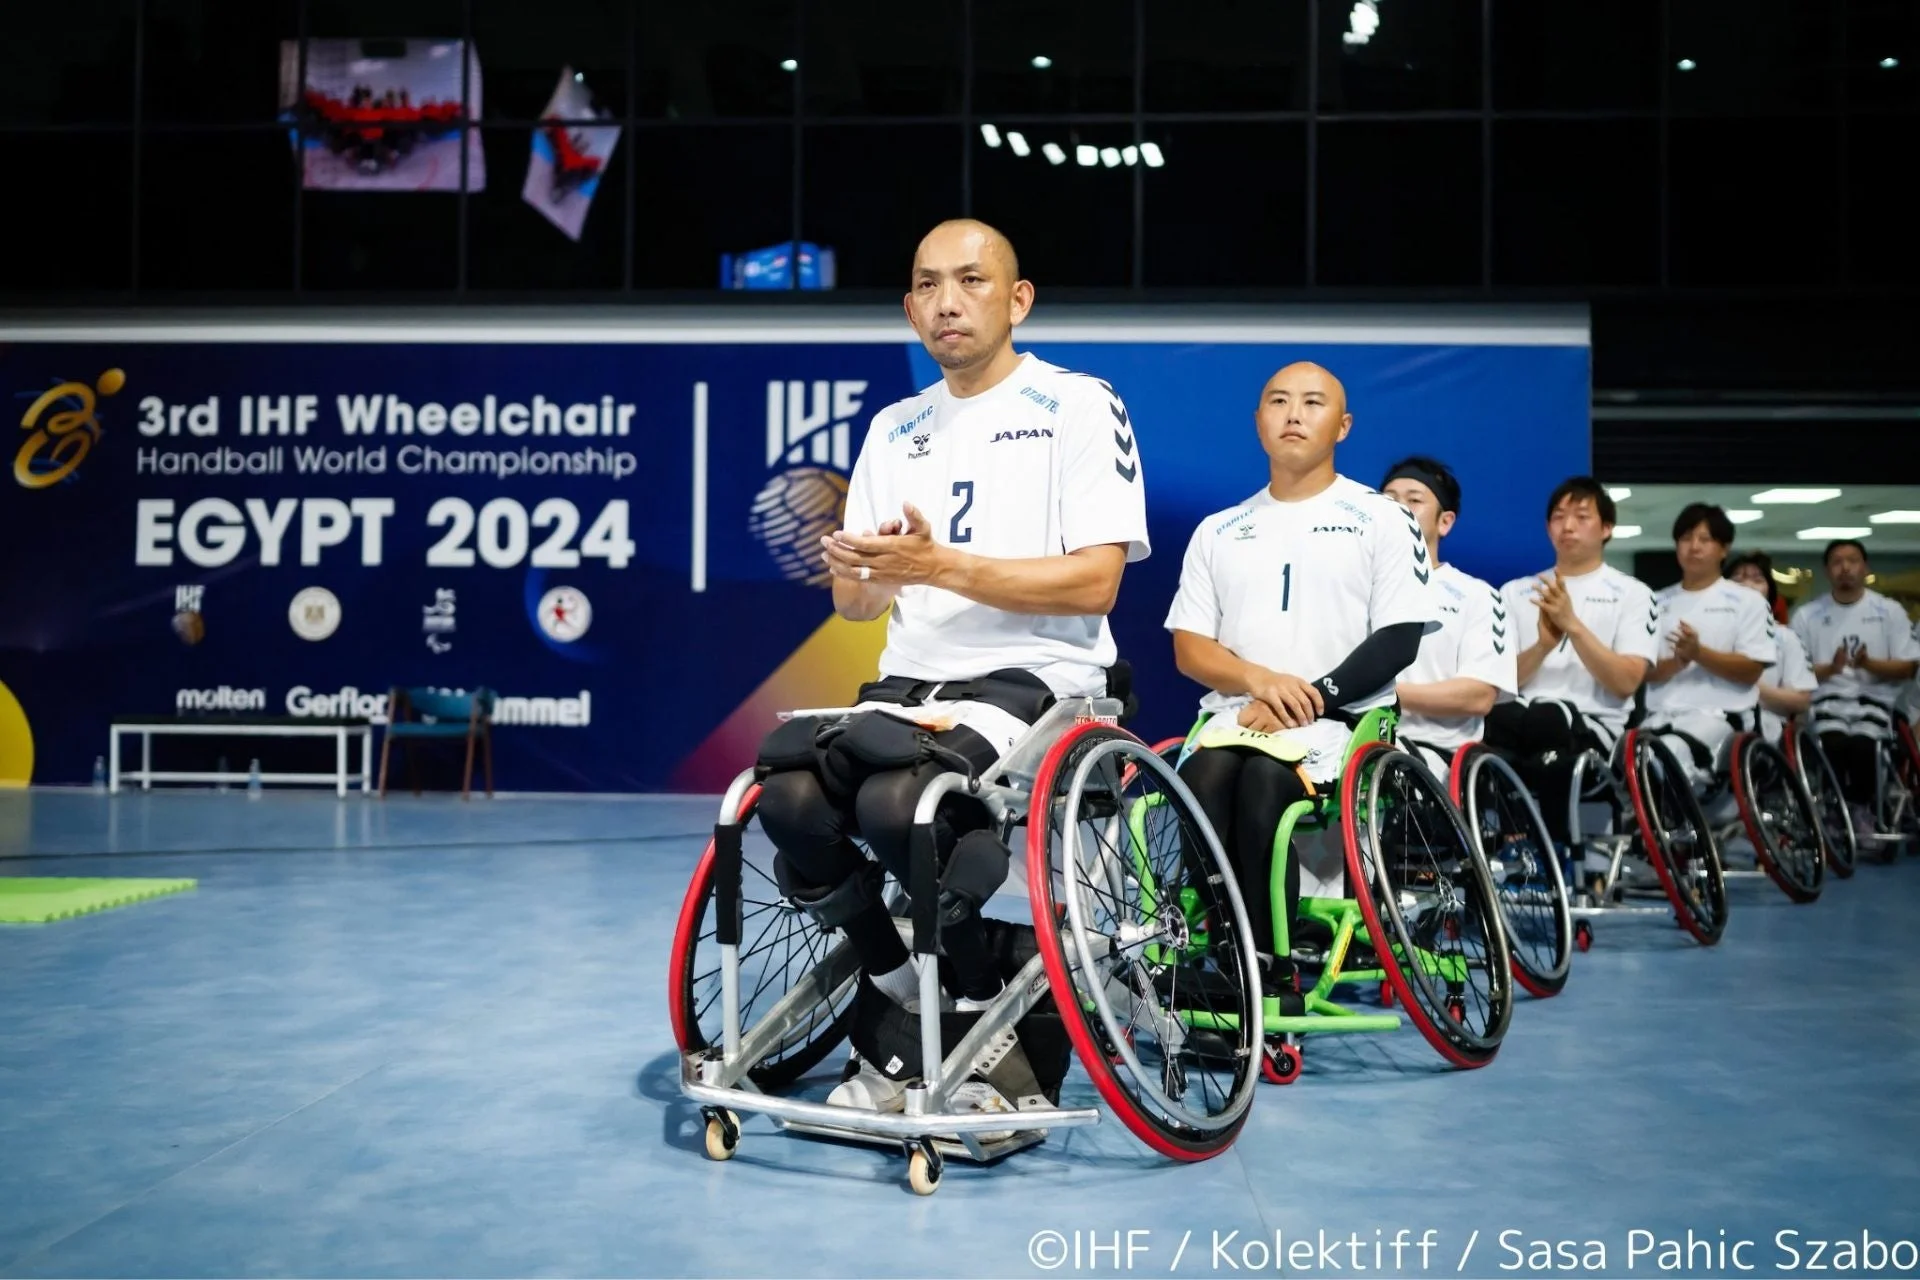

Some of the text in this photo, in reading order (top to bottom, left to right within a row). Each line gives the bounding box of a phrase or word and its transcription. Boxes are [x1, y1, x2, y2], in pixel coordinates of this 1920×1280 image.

[138, 394, 636, 436] 3rd IHF Wheelchair
[766, 380, 868, 470] IHF
[888, 404, 934, 443] OTARITEC
[990, 428, 1054, 443] JAPAN
[137, 444, 637, 479] Handball World Championship
[949, 480, 974, 544] 2
[135, 496, 636, 569] EGYPT 2024
[1308, 525, 1365, 537] JAPAN
[175, 584, 205, 612] IHF
[1281, 563, 1291, 612] 1
[176, 685, 266, 710] molten
[285, 684, 389, 717] Gerflor
[490, 690, 591, 727] mmel
